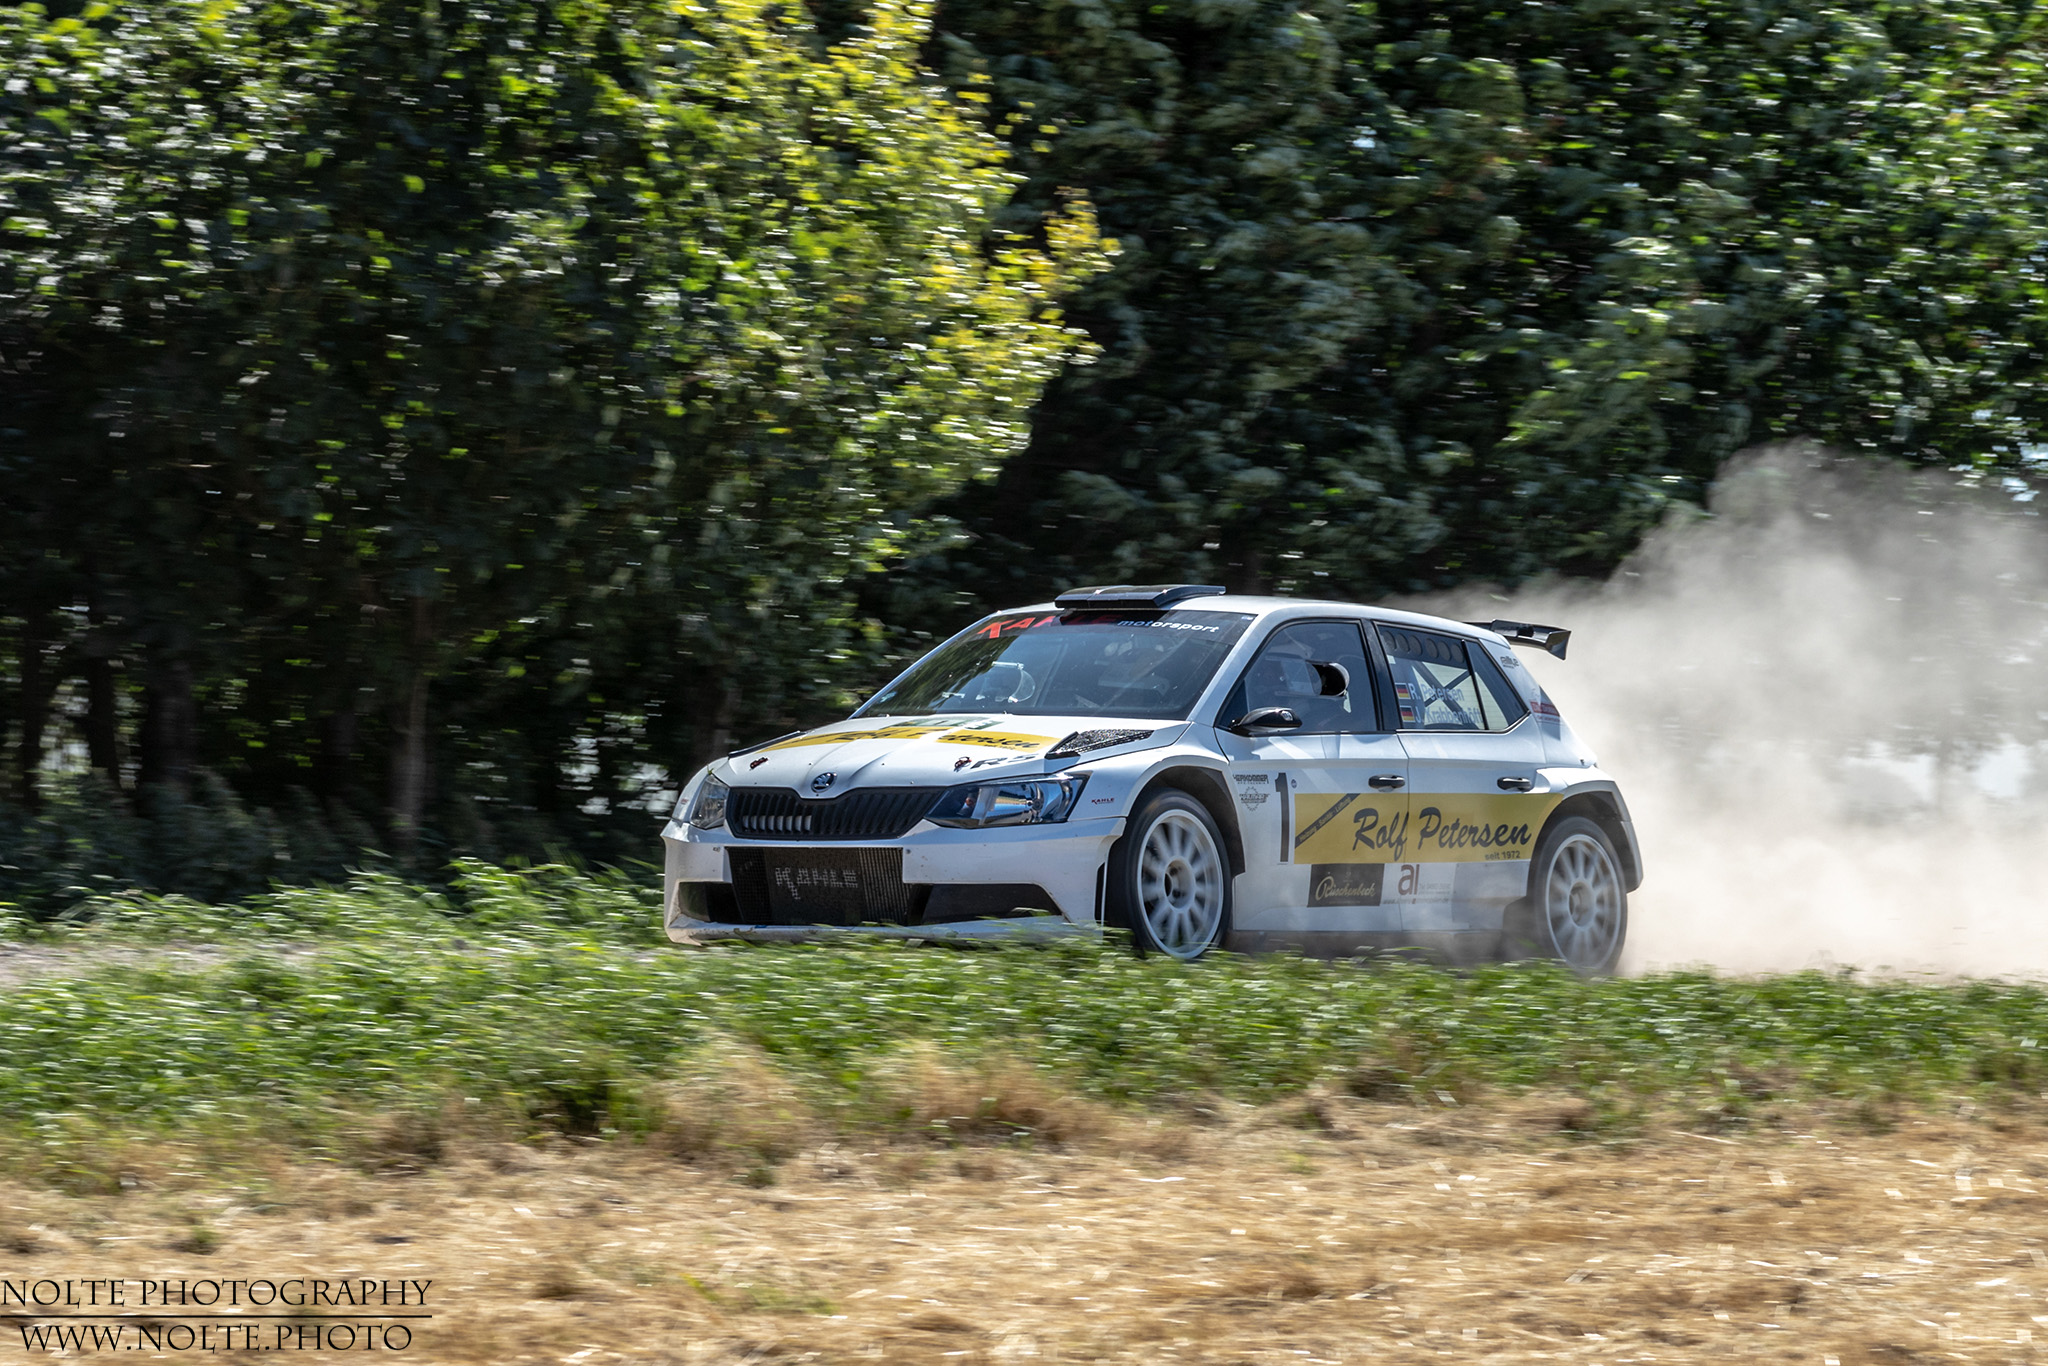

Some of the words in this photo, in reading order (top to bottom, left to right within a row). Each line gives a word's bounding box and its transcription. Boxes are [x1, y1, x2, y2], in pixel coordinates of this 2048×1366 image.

[1118, 619, 1220, 633] motorsport
[1275, 772, 1290, 863] 1
[1352, 807, 1409, 861] Rolf
[1418, 807, 1532, 850] Petersen
[1501, 850, 1521, 860] 1972
